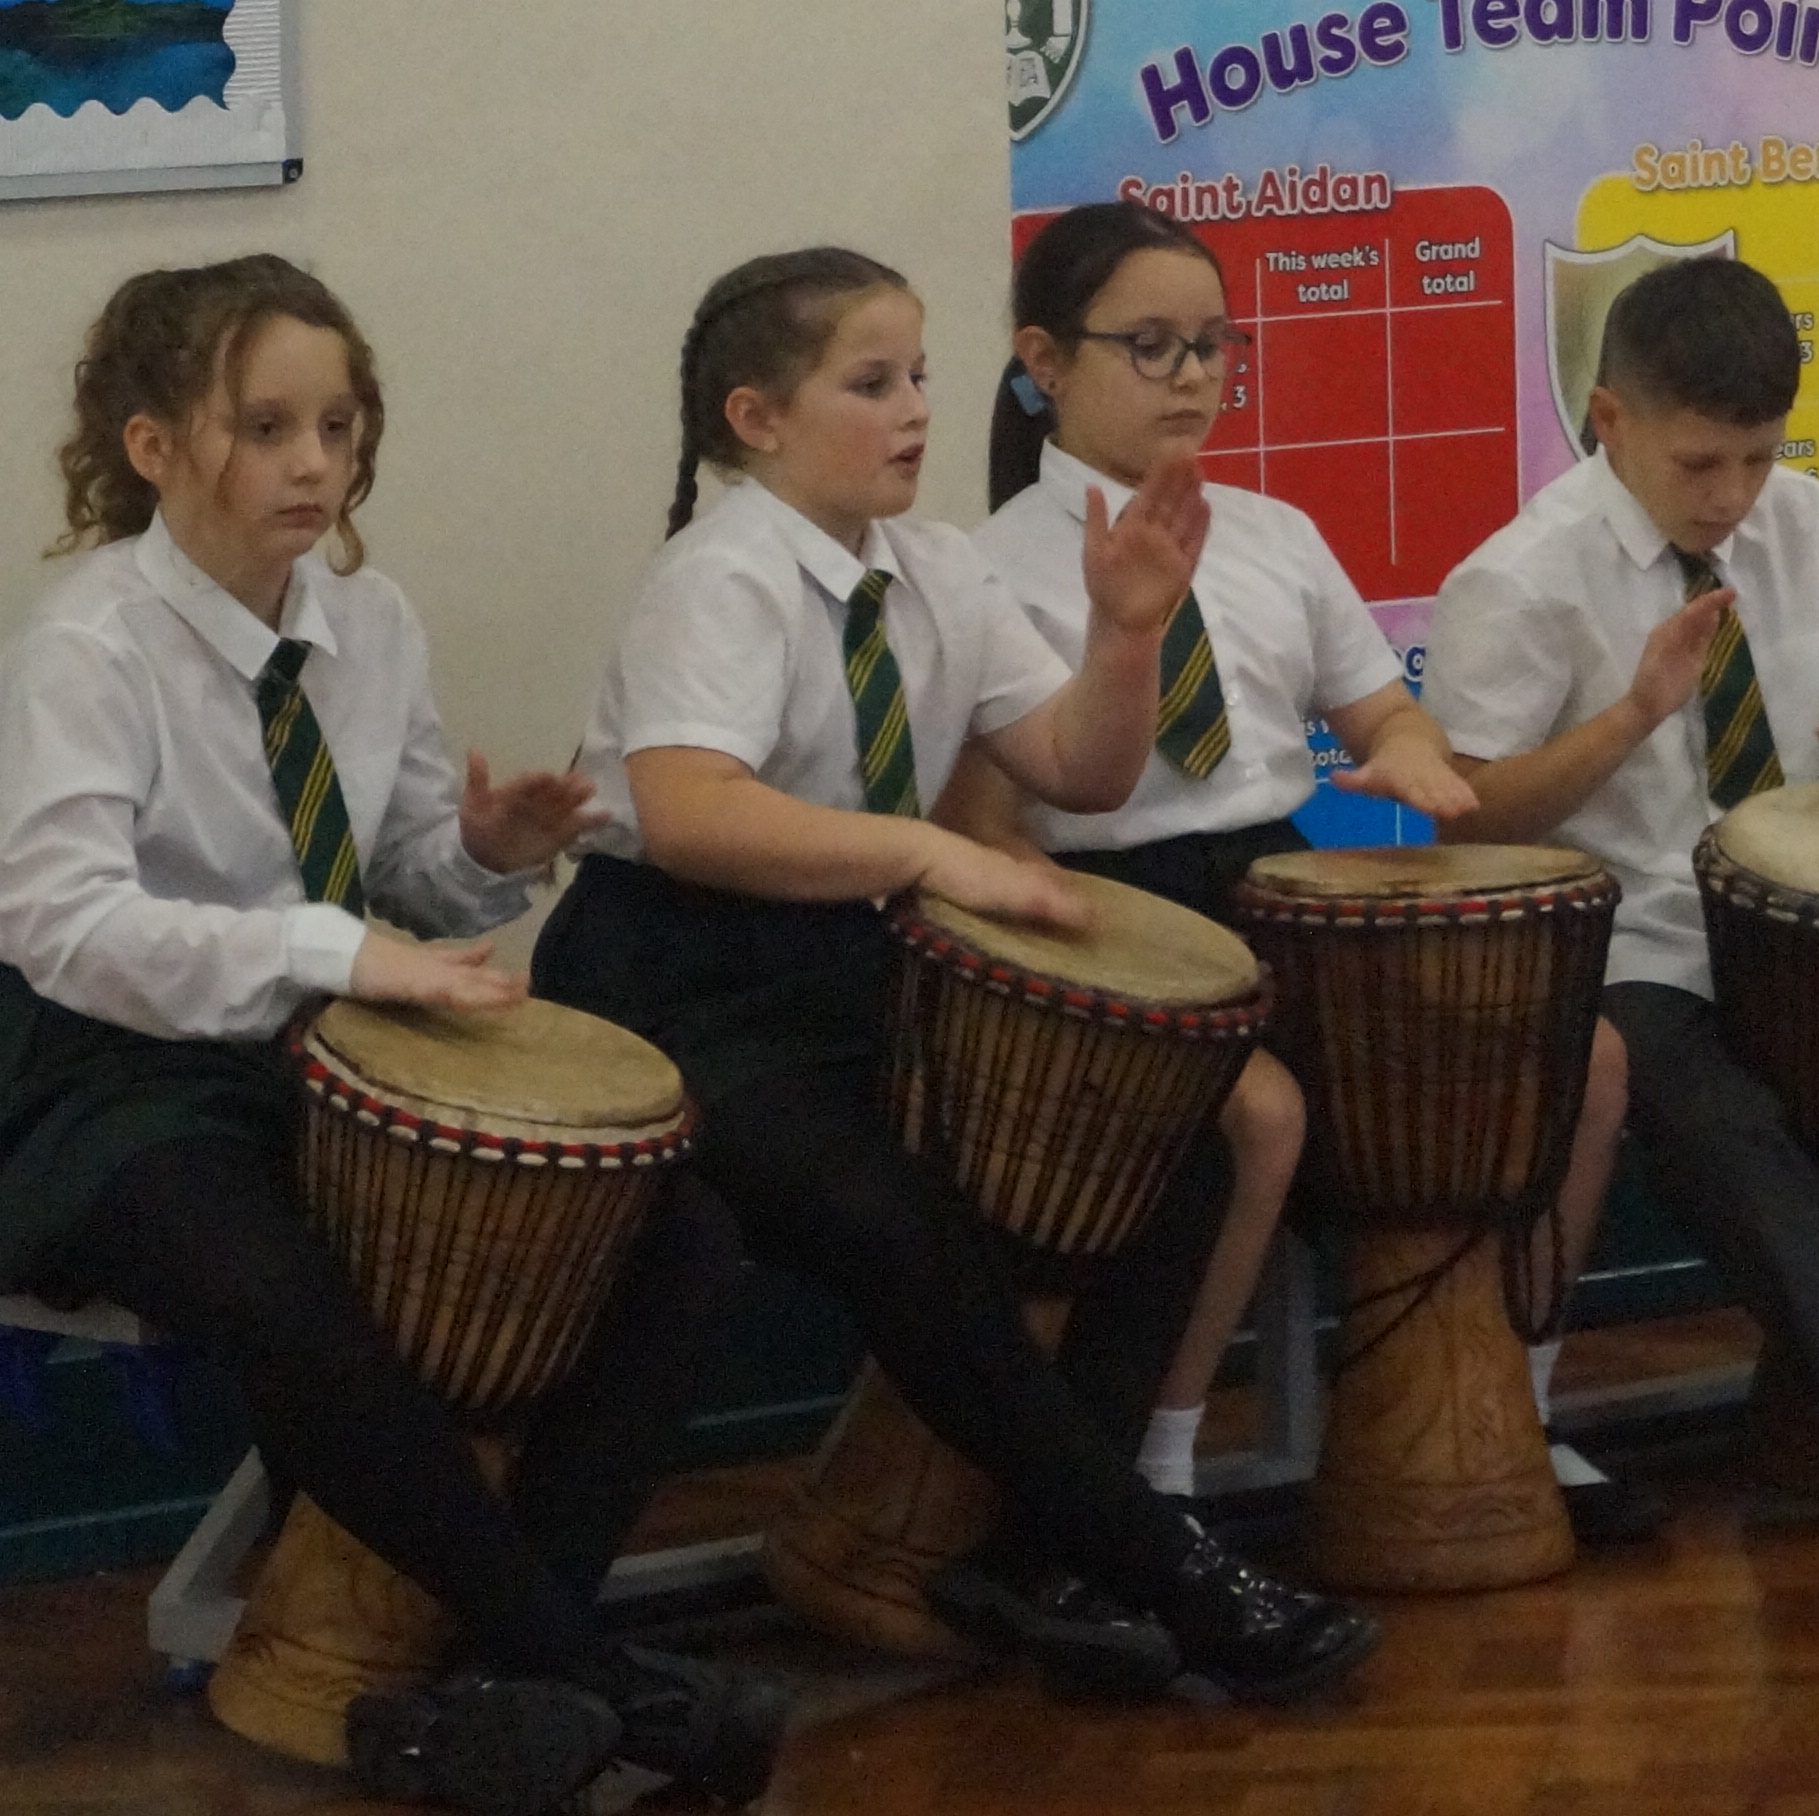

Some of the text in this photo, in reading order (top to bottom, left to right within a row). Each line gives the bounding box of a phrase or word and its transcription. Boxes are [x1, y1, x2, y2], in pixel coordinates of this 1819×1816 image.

[1140, 2, 1408, 142] House
[1632, 141, 1751, 190] Saint
[1252, 165, 1391, 216] Aidan
[1266, 245, 1379, 272] This week's
[1415, 237, 1480, 261] Grand
[1297, 280, 1349, 303] total
[1422, 271, 1475, 294] total
